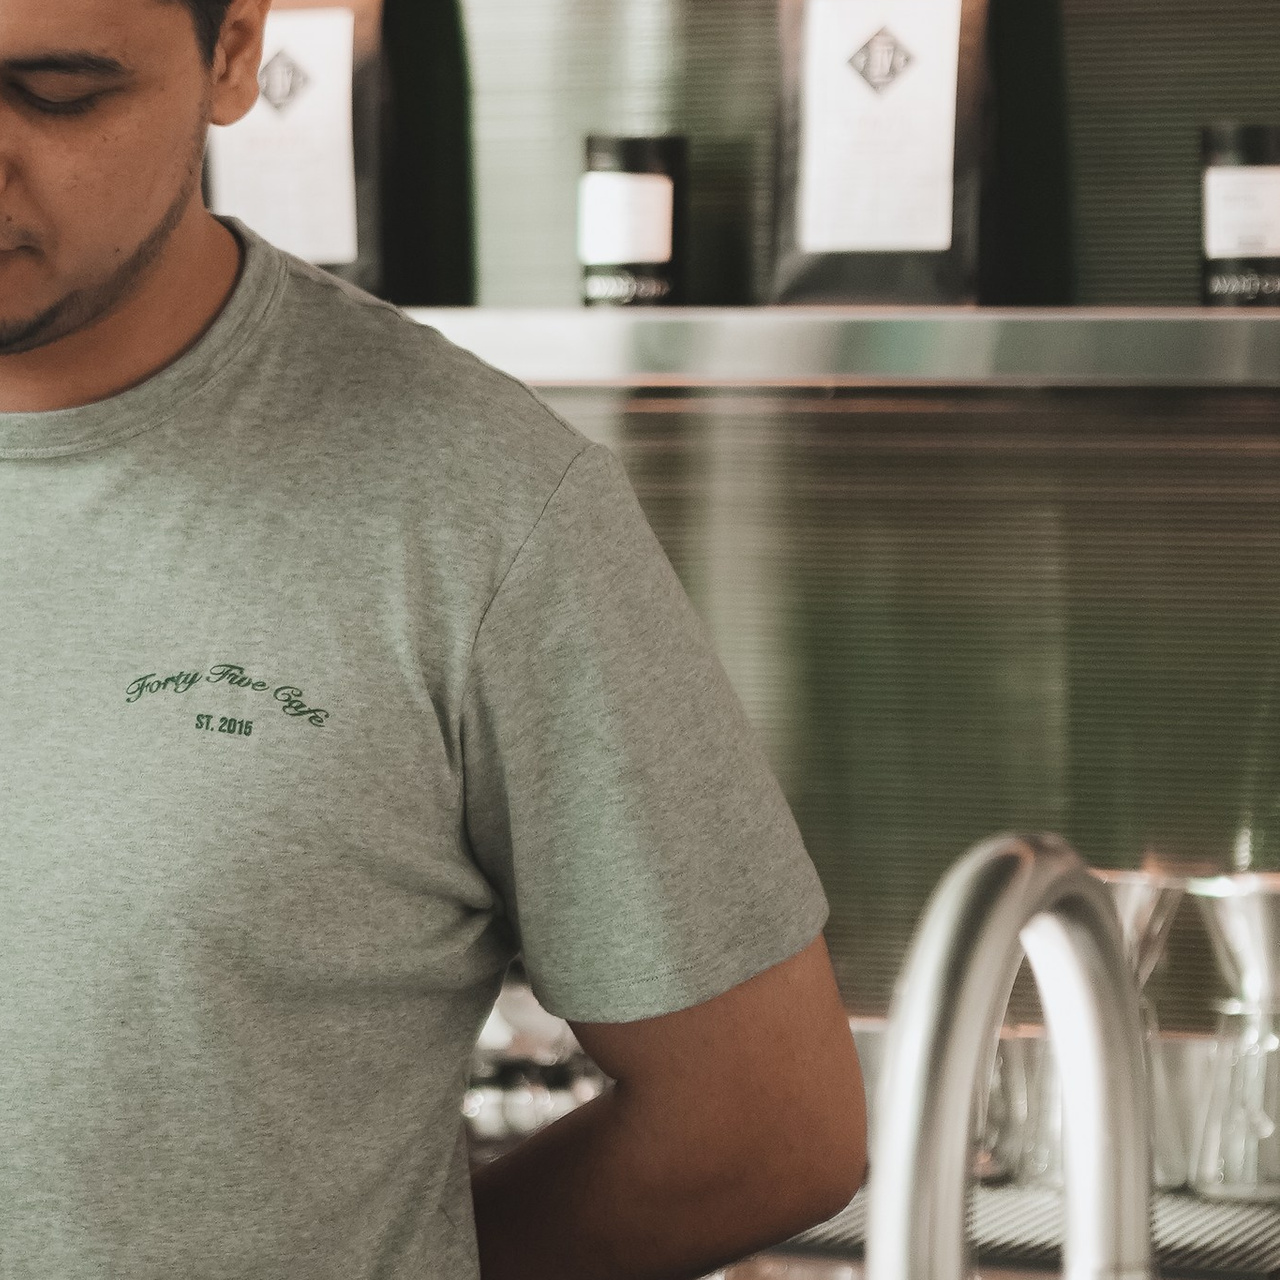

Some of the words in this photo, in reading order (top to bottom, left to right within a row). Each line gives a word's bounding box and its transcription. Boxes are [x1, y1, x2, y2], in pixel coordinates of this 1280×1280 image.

[126, 670, 202, 703] Forty
[206, 664, 269, 691] Five
[195, 714, 214, 731] ST.
[218, 717, 253, 736] 2015
